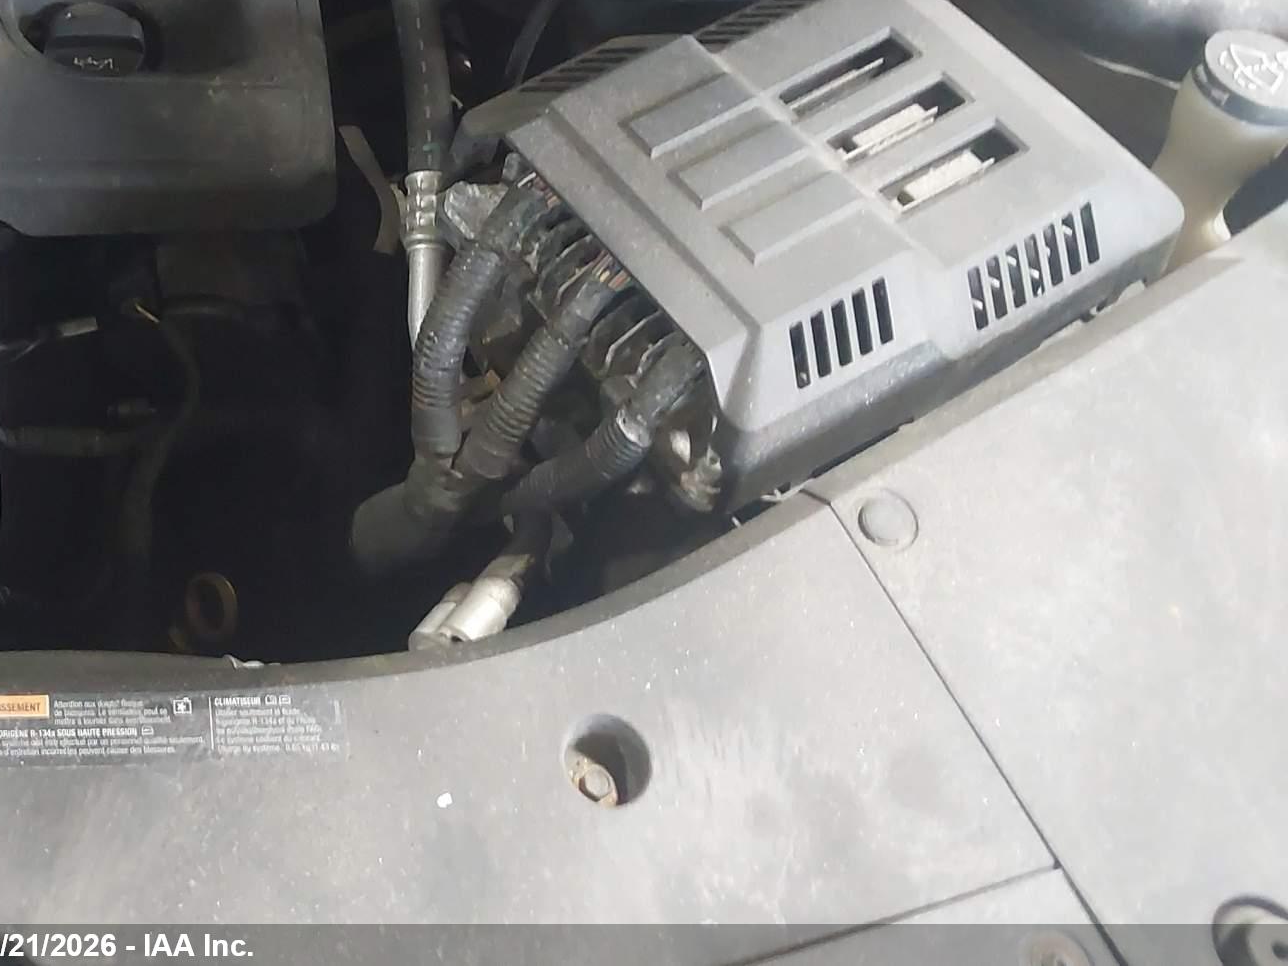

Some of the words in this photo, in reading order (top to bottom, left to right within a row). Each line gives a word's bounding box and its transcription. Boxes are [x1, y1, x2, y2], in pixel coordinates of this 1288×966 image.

[214, 697, 261, 706] CLIMATISEUR
[30, 729, 55, 738] R-134a
[57, 729, 76, 738] SOUS
[77, 729, 100, 738] HAUTE
[102, 728, 137, 737] PRESSION
